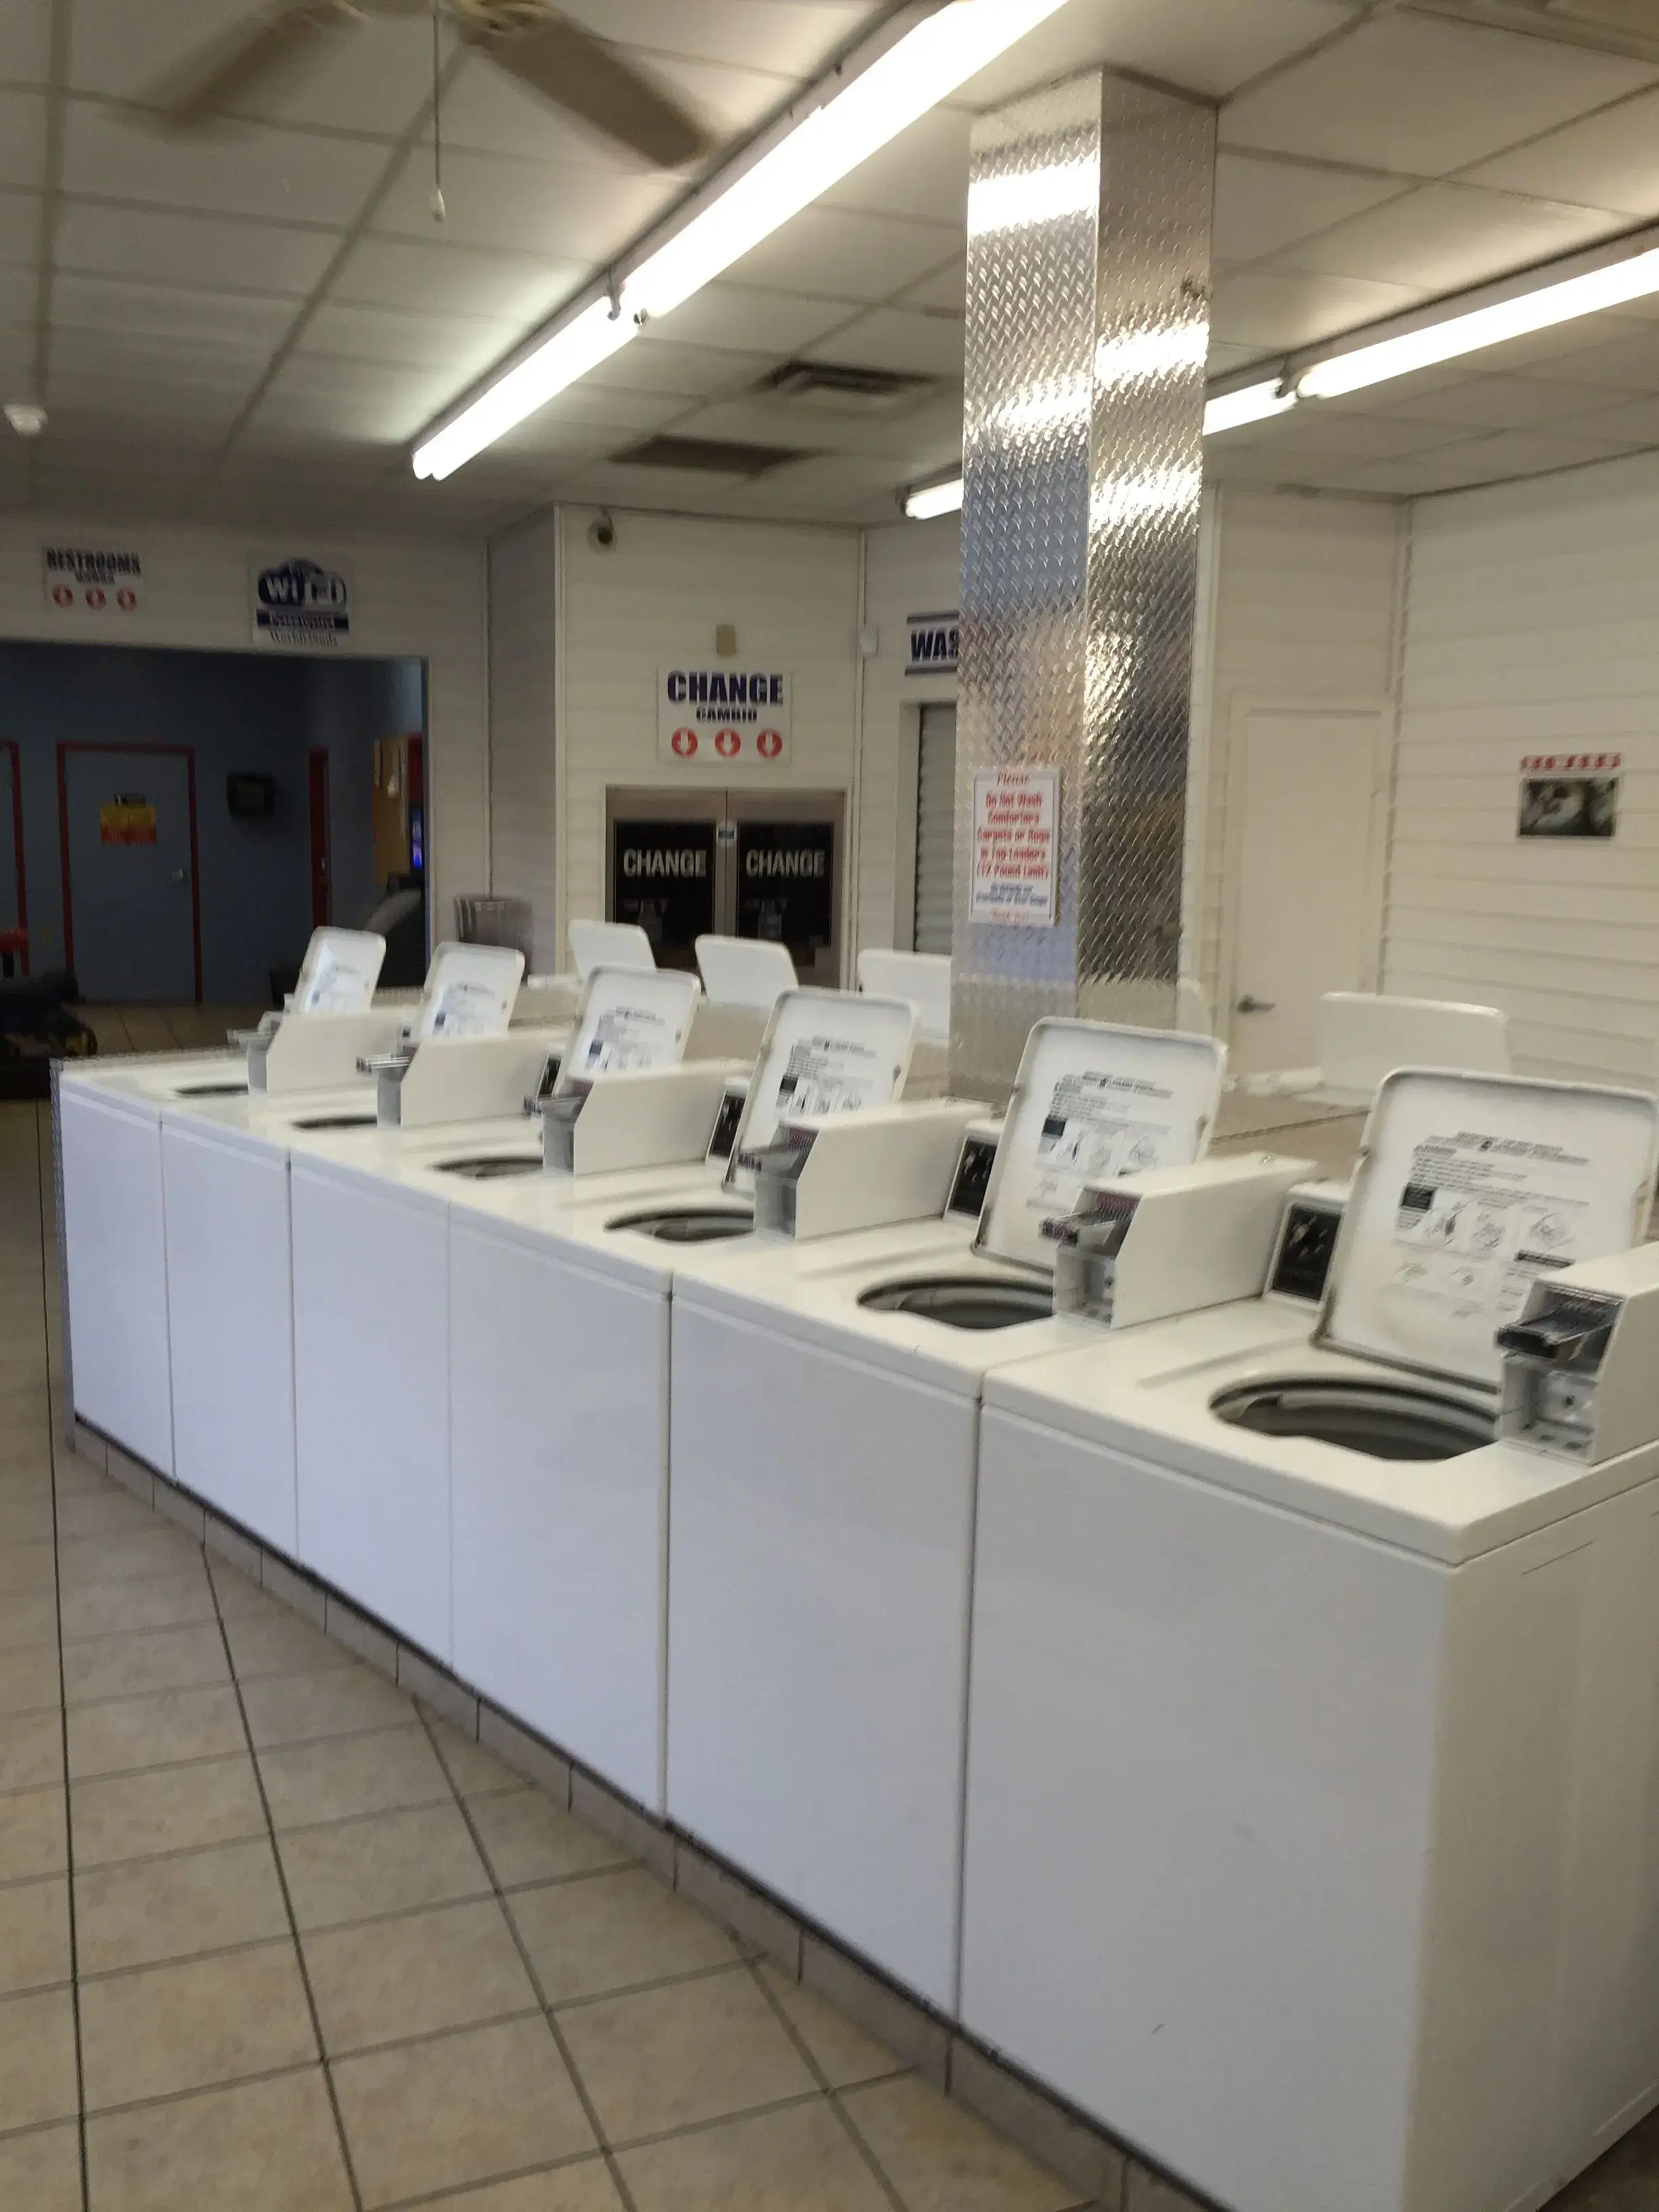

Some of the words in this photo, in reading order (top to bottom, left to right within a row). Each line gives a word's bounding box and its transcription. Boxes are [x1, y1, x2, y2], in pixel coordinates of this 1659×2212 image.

[668, 671, 783, 706] CHANGE
[696, 706, 758, 724] CAMBIO
[985, 792, 997, 808] Do
[999, 792, 1015, 808] Not
[1017, 792, 1042, 808] Wash
[988, 810, 1040, 825] Comforters
[624, 848, 708, 878] CHANGE
[746, 848, 825, 878] CHANGE
